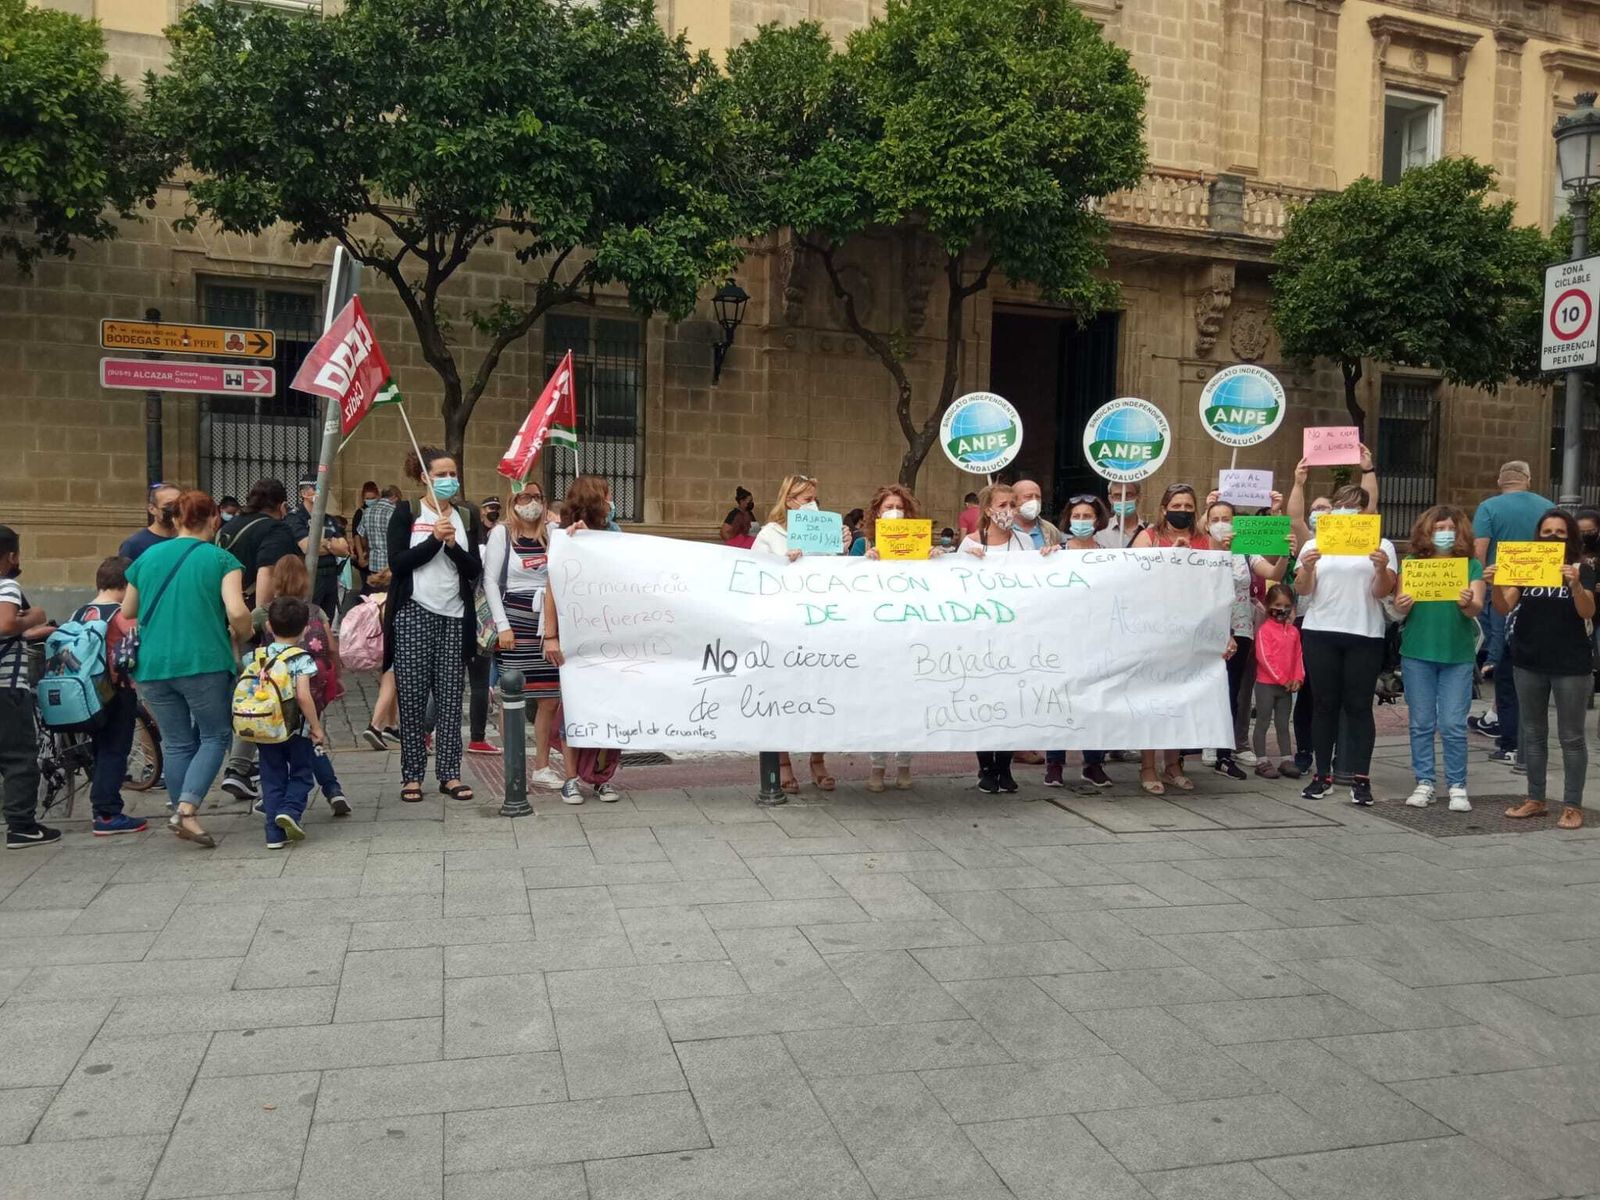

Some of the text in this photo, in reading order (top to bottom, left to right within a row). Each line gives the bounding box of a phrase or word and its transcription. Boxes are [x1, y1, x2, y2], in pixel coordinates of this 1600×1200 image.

[1562, 264, 1583, 276] ZONA
[1554, 273, 1591, 288] CICLABLE
[1562, 306, 1580, 323] 10
[106, 333, 161, 346] BODEGAS
[193, 339, 220, 349] PEPE
[1543, 340, 1595, 355] PREFERENCIA
[1552, 352, 1584, 366] PEATÓN
[133, 371, 173, 381] ALCAZAR
[1205, 367, 1283, 399] SINDICATO INDEPENDIENTE
[943, 395, 1017, 428] SINDICATO INDEPENDIENTE
[1089, 401, 1168, 432] SINDICATO INDEPENDIENTE
[1213, 408, 1267, 425] ANPE
[957, 433, 1008, 455] ANPE
[1215, 432, 1263, 445] ANDALUCÍA
[1098, 442, 1153, 460] ANPE
[964, 456, 1010, 473] ANDALUCÍA
[1101, 468, 1149, 482] ANDALUCÍA
[1224, 473, 1260, 481] NO AL
[795, 513, 833, 524] BAJADA
[806, 524, 820, 532] DE
[1243, 539, 1273, 547] COVID
[1123, 551, 1165, 571] Miguel
[1170, 552, 1182, 566] de
[1186, 551, 1233, 569] Cervantes
[561, 558, 689, 598] Permanencia
[728, 559, 1091, 597] EDUCACIÓN PÚBLICA
[1406, 570, 1458, 579] PLENA AL
[1404, 579, 1463, 588] ALUMNADO
[1522, 585, 1569, 599] LOVE
[1416, 590, 1443, 598] NEE
[565, 600, 675, 635] Refuerzos
[797, 598, 1017, 626] DE CALIDAD
[744, 640, 775, 669] al
[783, 644, 861, 669] cierre
[909, 640, 1062, 692] Bajada de
[688, 687, 720, 723] de
[925, 689, 1008, 730] ratios
[566, 720, 717, 744] CEIP Miguel de Cervantes
